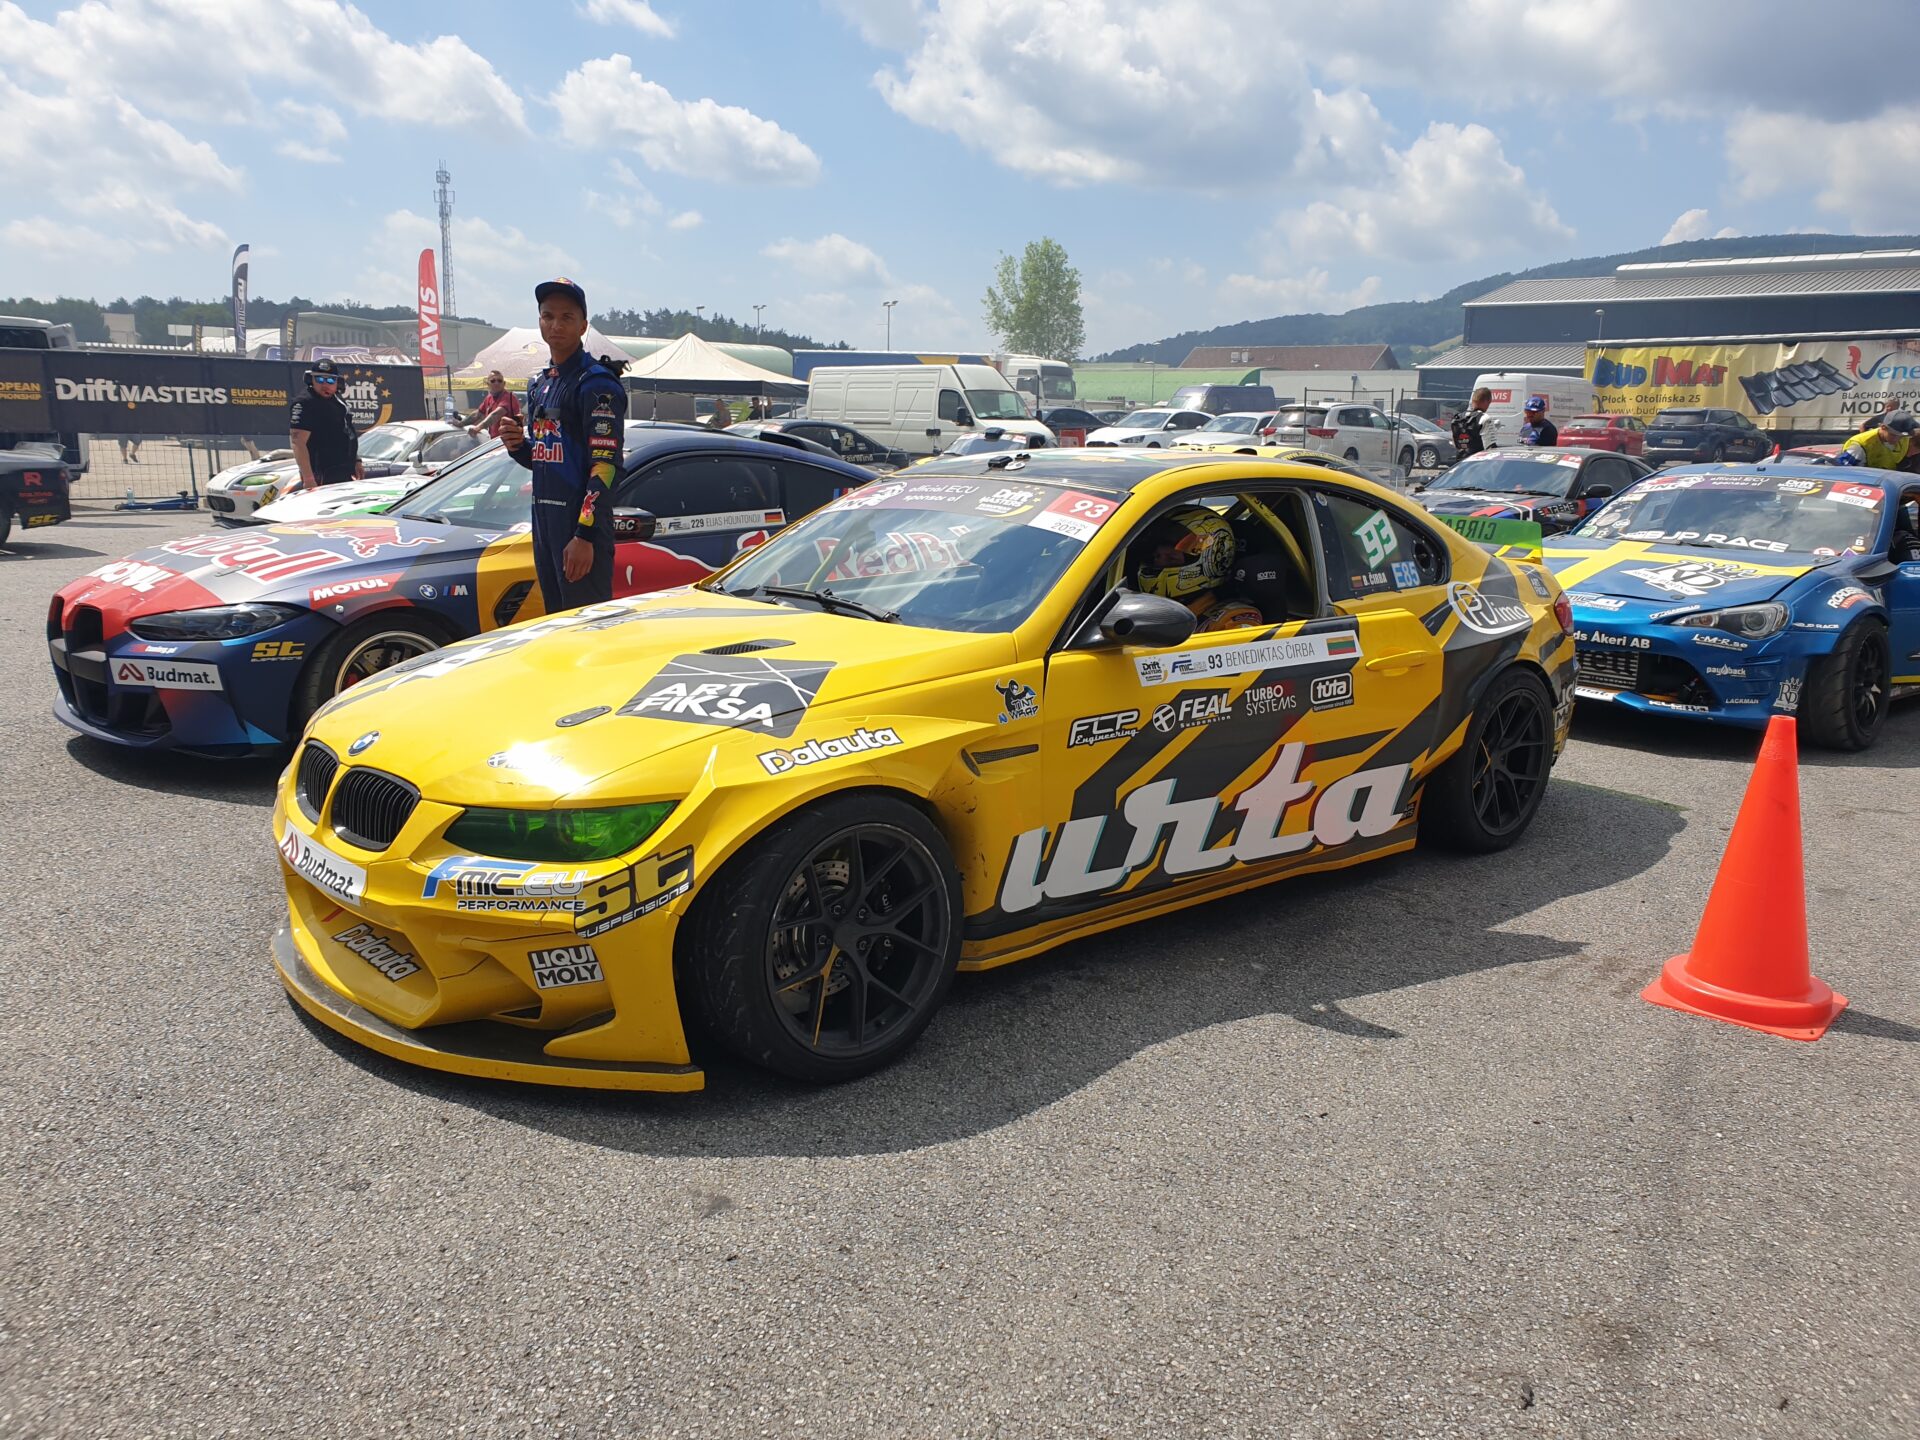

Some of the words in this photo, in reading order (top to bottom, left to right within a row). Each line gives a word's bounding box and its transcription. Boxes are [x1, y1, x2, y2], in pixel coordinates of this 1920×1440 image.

[420, 287, 441, 356] AVIS
[1592, 357, 1647, 388] BUD
[1651, 356, 1728, 387] MAT
[0, 382, 40, 391] OPEAN
[55, 377, 119, 401] Drift
[119, 384, 228, 404] MASTERS
[230, 388, 287, 398] EUROPEAN
[345, 400, 379, 410] STERS
[1601, 395, 1626, 404] Płock
[1635, 394, 1685, 403] Otolińska
[1688, 394, 1701, 403] 25
[908, 484, 945, 493] official
[945, 485, 979, 494] ECU
[991, 488, 1034, 502] Drift
[1846, 486, 1873, 497] 68
[979, 496, 1024, 508] MASTERS
[1070, 499, 1109, 518] 93
[613, 519, 636, 531] TeC
[691, 519, 705, 528] 229
[706, 518, 724, 527] ELIAS
[1050, 522, 1082, 536] 2021
[1353, 510, 1398, 569] 93
[1702, 533, 1790, 553] RACE
[1393, 562, 1420, 587] E85
[313, 578, 388, 601] MOTUL
[1630, 637, 1651, 649] AB
[1208, 654, 1223, 669] 93
[1225, 646, 1284, 667] BENEDIKTAS
[1285, 642, 1315, 661] ČIRBA
[147, 666, 215, 685] Budmat.
[1142, 661, 1161, 671] Drift
[651, 682, 759, 698] ART
[1245, 685, 1283, 703] TURBO
[633, 696, 774, 728] FIKSA
[1178, 692, 1232, 721] FEAL
[1246, 696, 1297, 716] SYSTEMS
[1180, 715, 1231, 728] Suspension
[1075, 728, 1140, 746] Engineering
[756, 727, 904, 775] Dalauta
[1001, 741, 1411, 913] urta
[299, 846, 355, 900] Budmat.
[457, 899, 586, 911] PERFORMANCE
[577, 884, 690, 938] SUSPENSIONS
[332, 923, 422, 983] Dalauta
[531, 946, 596, 969] LIQUI
[538, 963, 602, 987] MOLY
